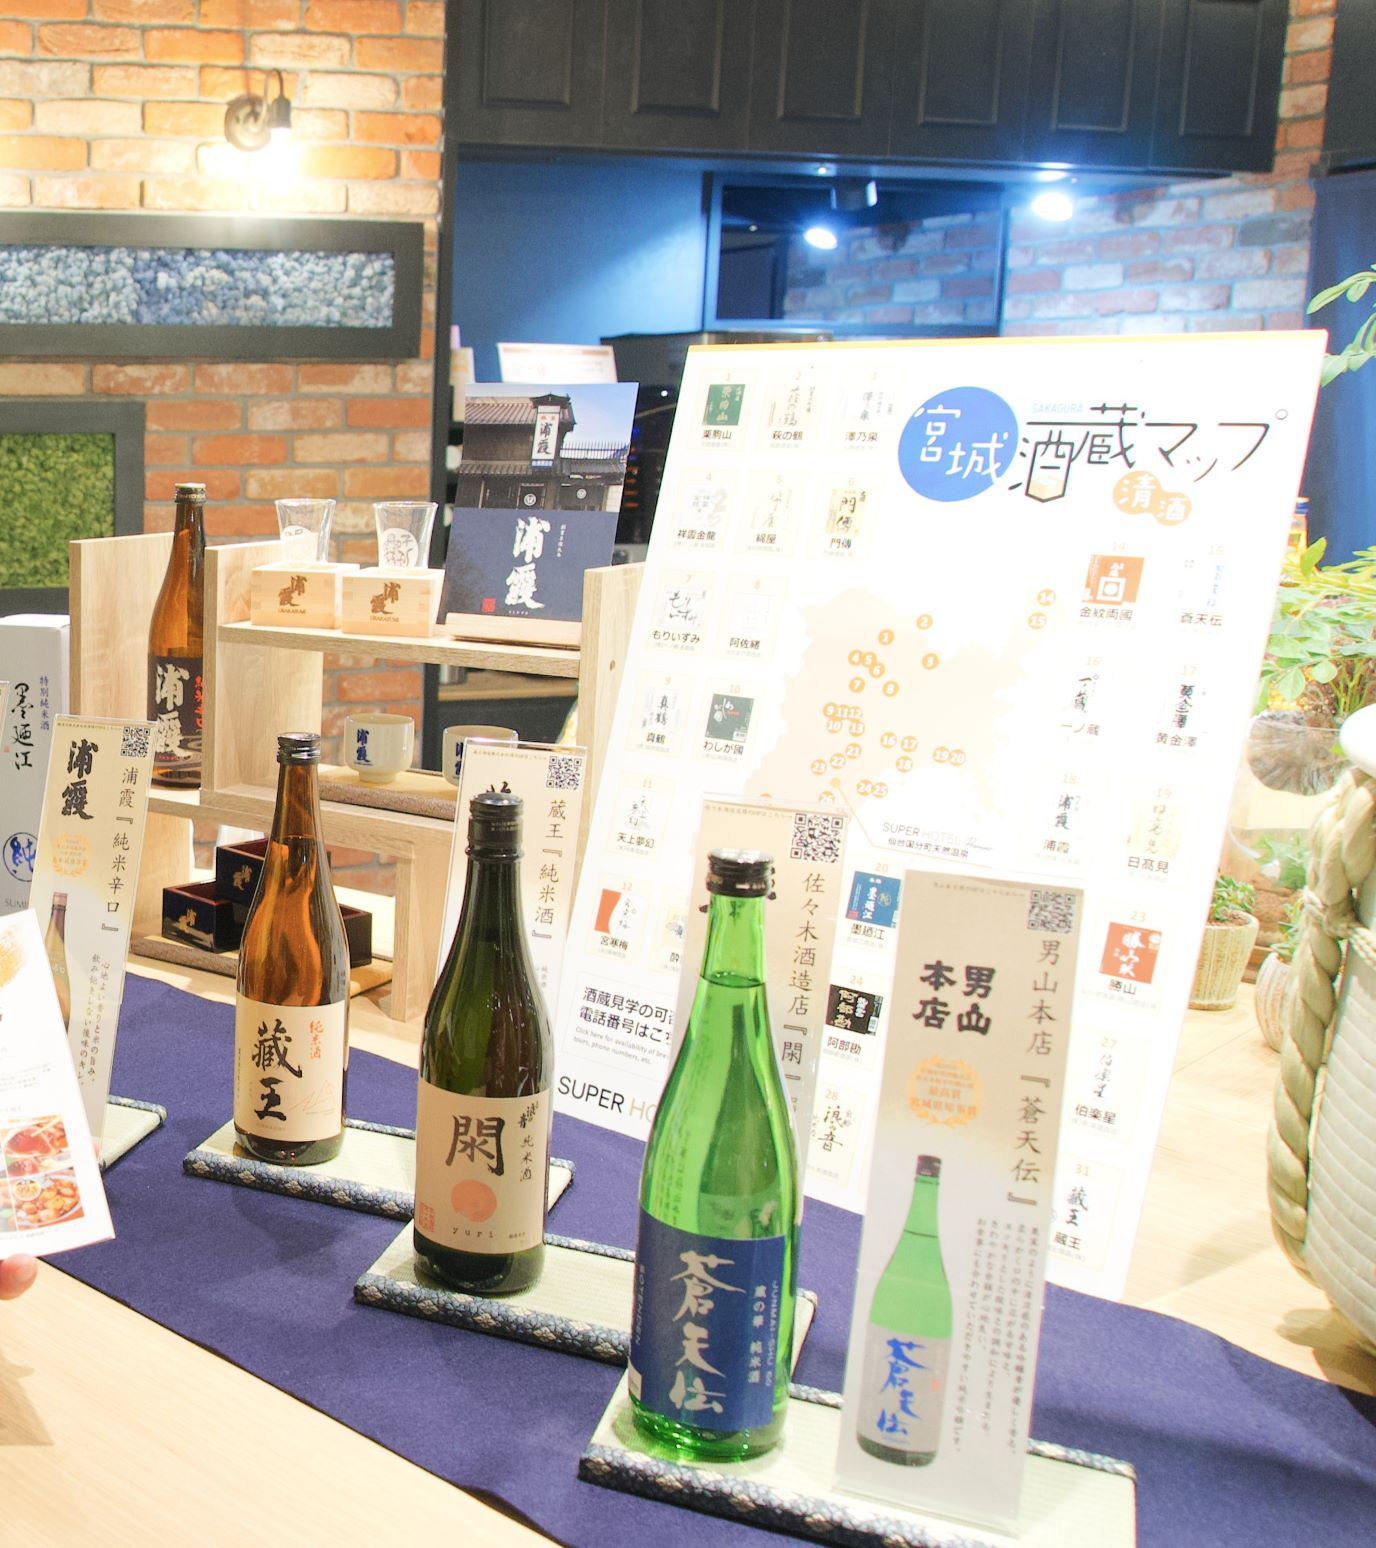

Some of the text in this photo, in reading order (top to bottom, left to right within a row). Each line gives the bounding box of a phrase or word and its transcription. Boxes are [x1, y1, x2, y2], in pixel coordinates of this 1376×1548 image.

[913, 402, 1289, 503] 宮城 酒蔵マップ
[1119, 474, 1187, 522] 清酒
[505, 516, 551, 610] 浦霞
[1180, 612, 1224, 626] 蒼天伝
[652, 630, 700, 644] もりいずみ
[1060, 723, 1101, 737] 一ノ蔵
[61, 738, 98, 821] 浦霞
[882, 822, 920, 837] SUPER
[101, 766, 141, 933] 浦霞『純米辛口』
[532, 800, 566, 940] 蔵王『純米酒』
[875, 863, 889, 873] 20
[850, 974, 864, 986] 24
[1008, 939, 1061, 1205] 男山本店『蒼天伝』
[557, 1075, 626, 1115] SUPER
[1076, 1104, 1116, 1125] 伯楽星
[445, 1114, 506, 1177] 閖
[451, 1227, 496, 1239] yuri
[1053, 1231, 1082, 1251] 蔵王
